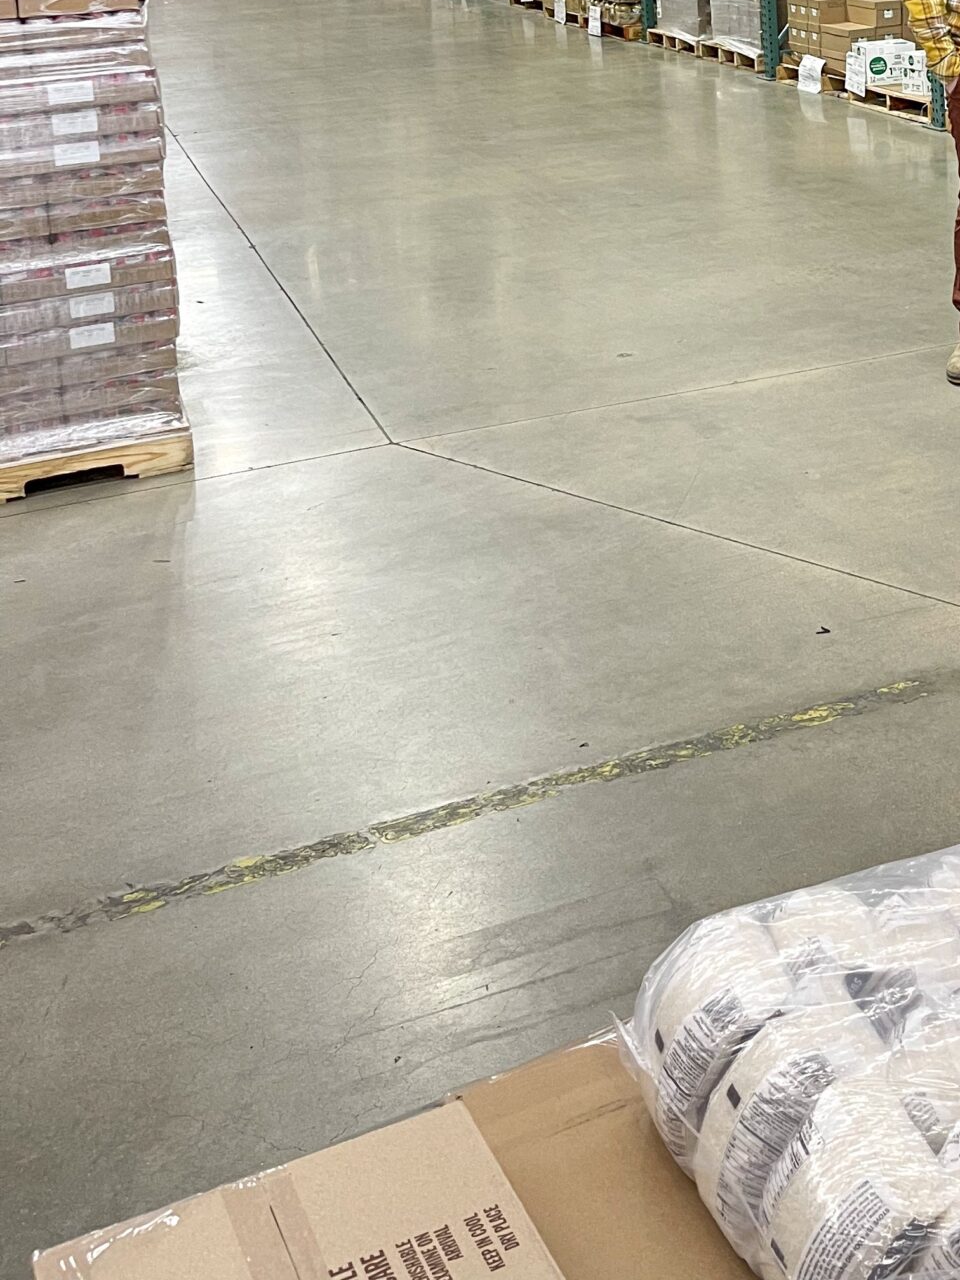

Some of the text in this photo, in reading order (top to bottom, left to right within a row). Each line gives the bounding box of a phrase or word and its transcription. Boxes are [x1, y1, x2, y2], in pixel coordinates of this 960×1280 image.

[414, 1231, 433, 1248] ON
[433, 1224, 464, 1261] ARRIVAL
[463, 1212, 506, 1272] KEEP IN COOL
[483, 1204, 521, 1252] DRY PLACE
